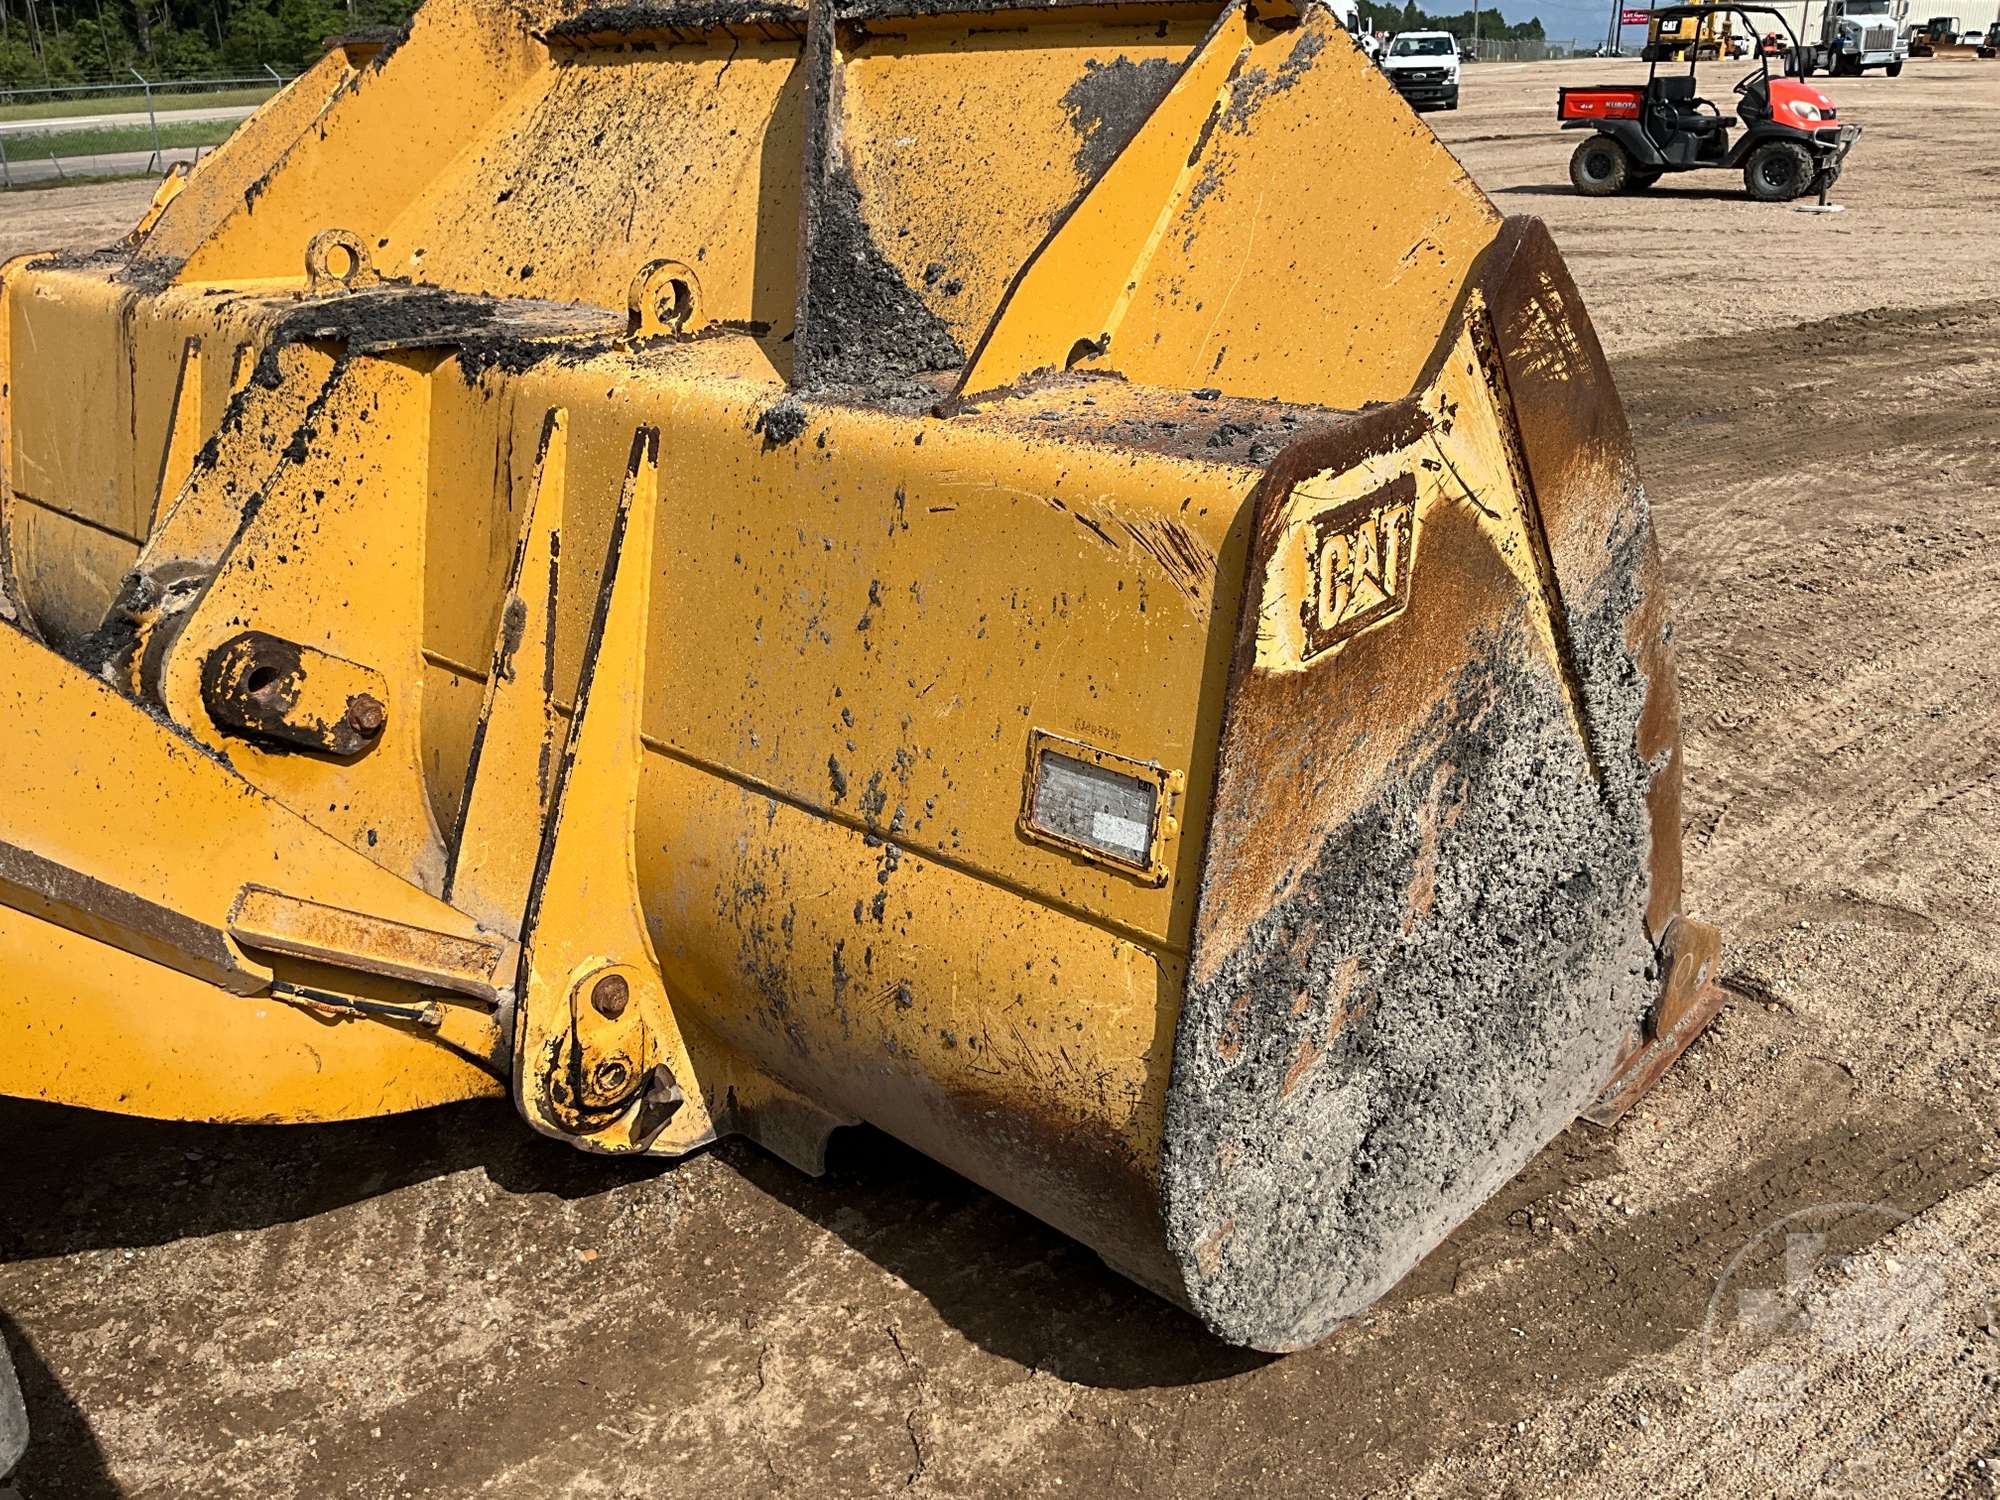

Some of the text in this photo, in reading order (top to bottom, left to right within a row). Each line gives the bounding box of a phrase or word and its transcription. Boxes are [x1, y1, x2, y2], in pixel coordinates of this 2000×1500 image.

[1662, 20, 1678, 31] CAT
[1605, 101, 1637, 109] KUBOTA
[1319, 504, 1408, 630] CAT
